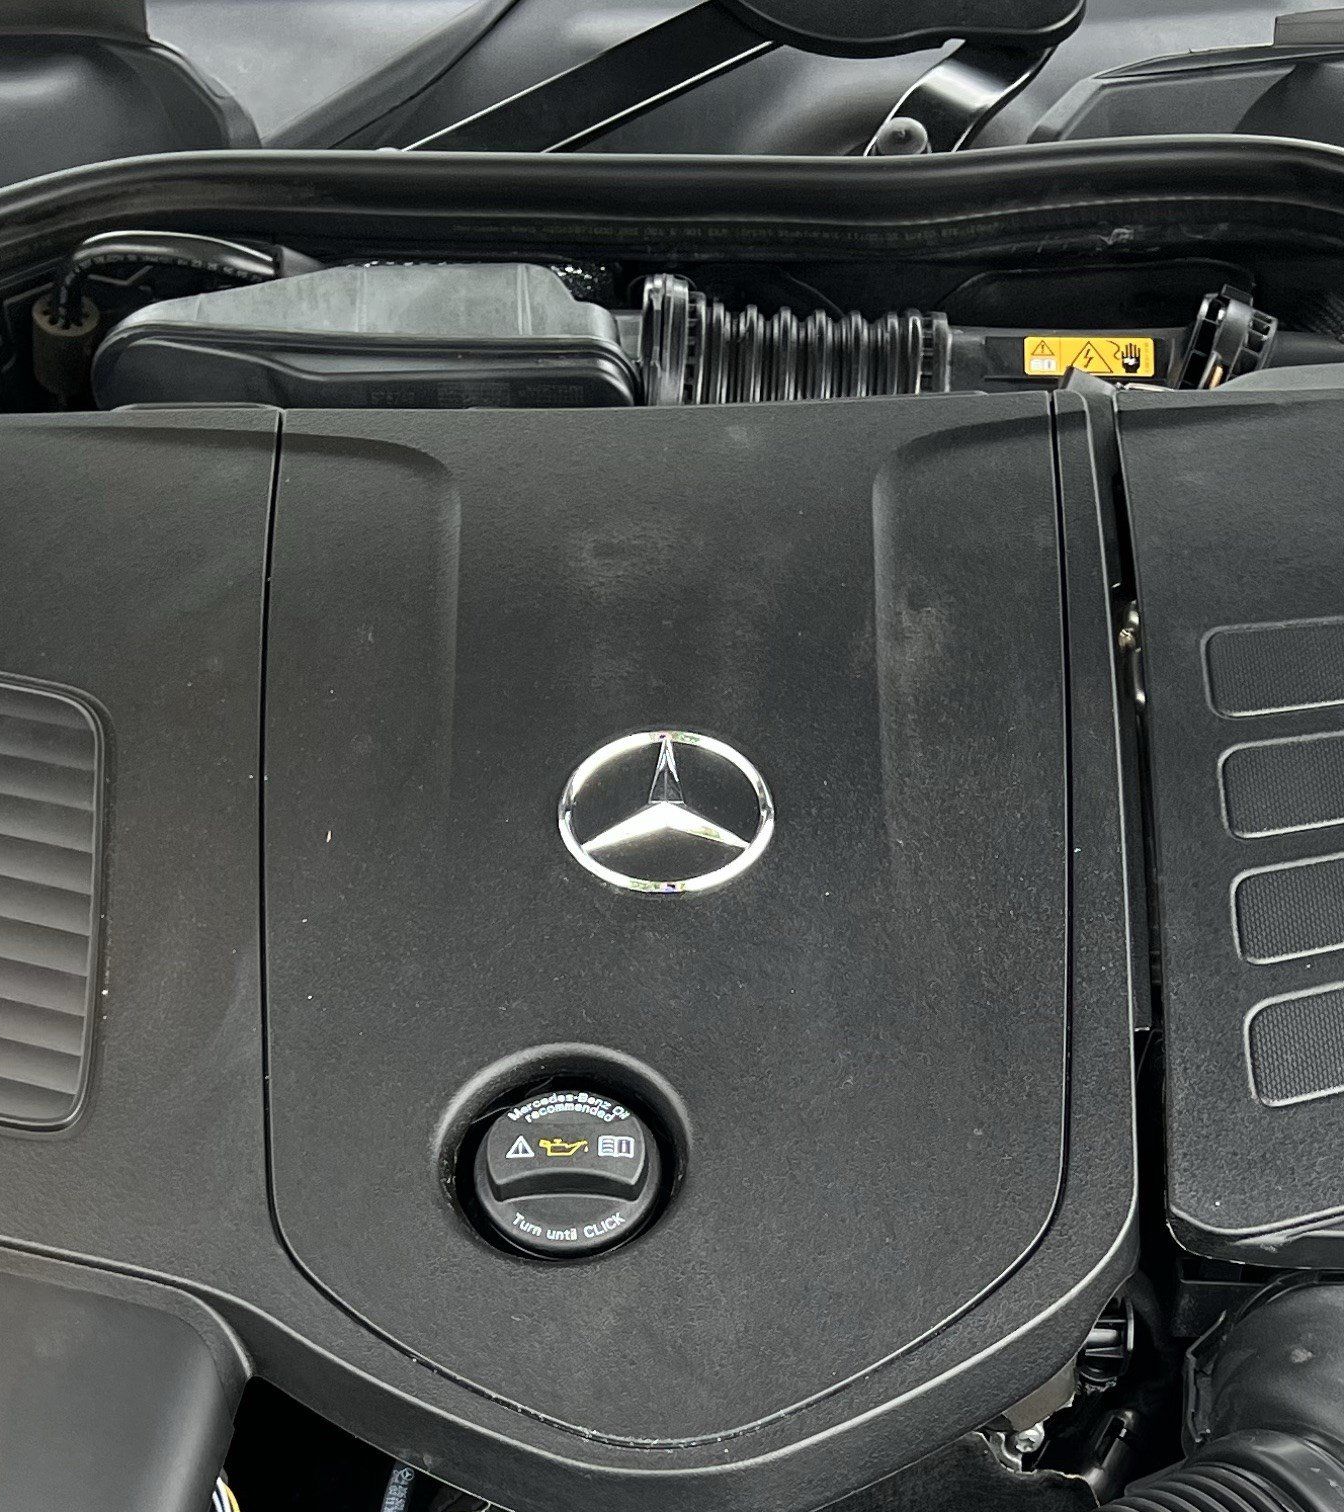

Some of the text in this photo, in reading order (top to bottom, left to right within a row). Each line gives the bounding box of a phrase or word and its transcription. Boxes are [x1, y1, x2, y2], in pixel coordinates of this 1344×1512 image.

[507, 1092, 613, 1122] Mercedes-Benz
[524, 1104, 615, 1123] recommended
[512, 1211, 627, 1241] Turn until CLICK
